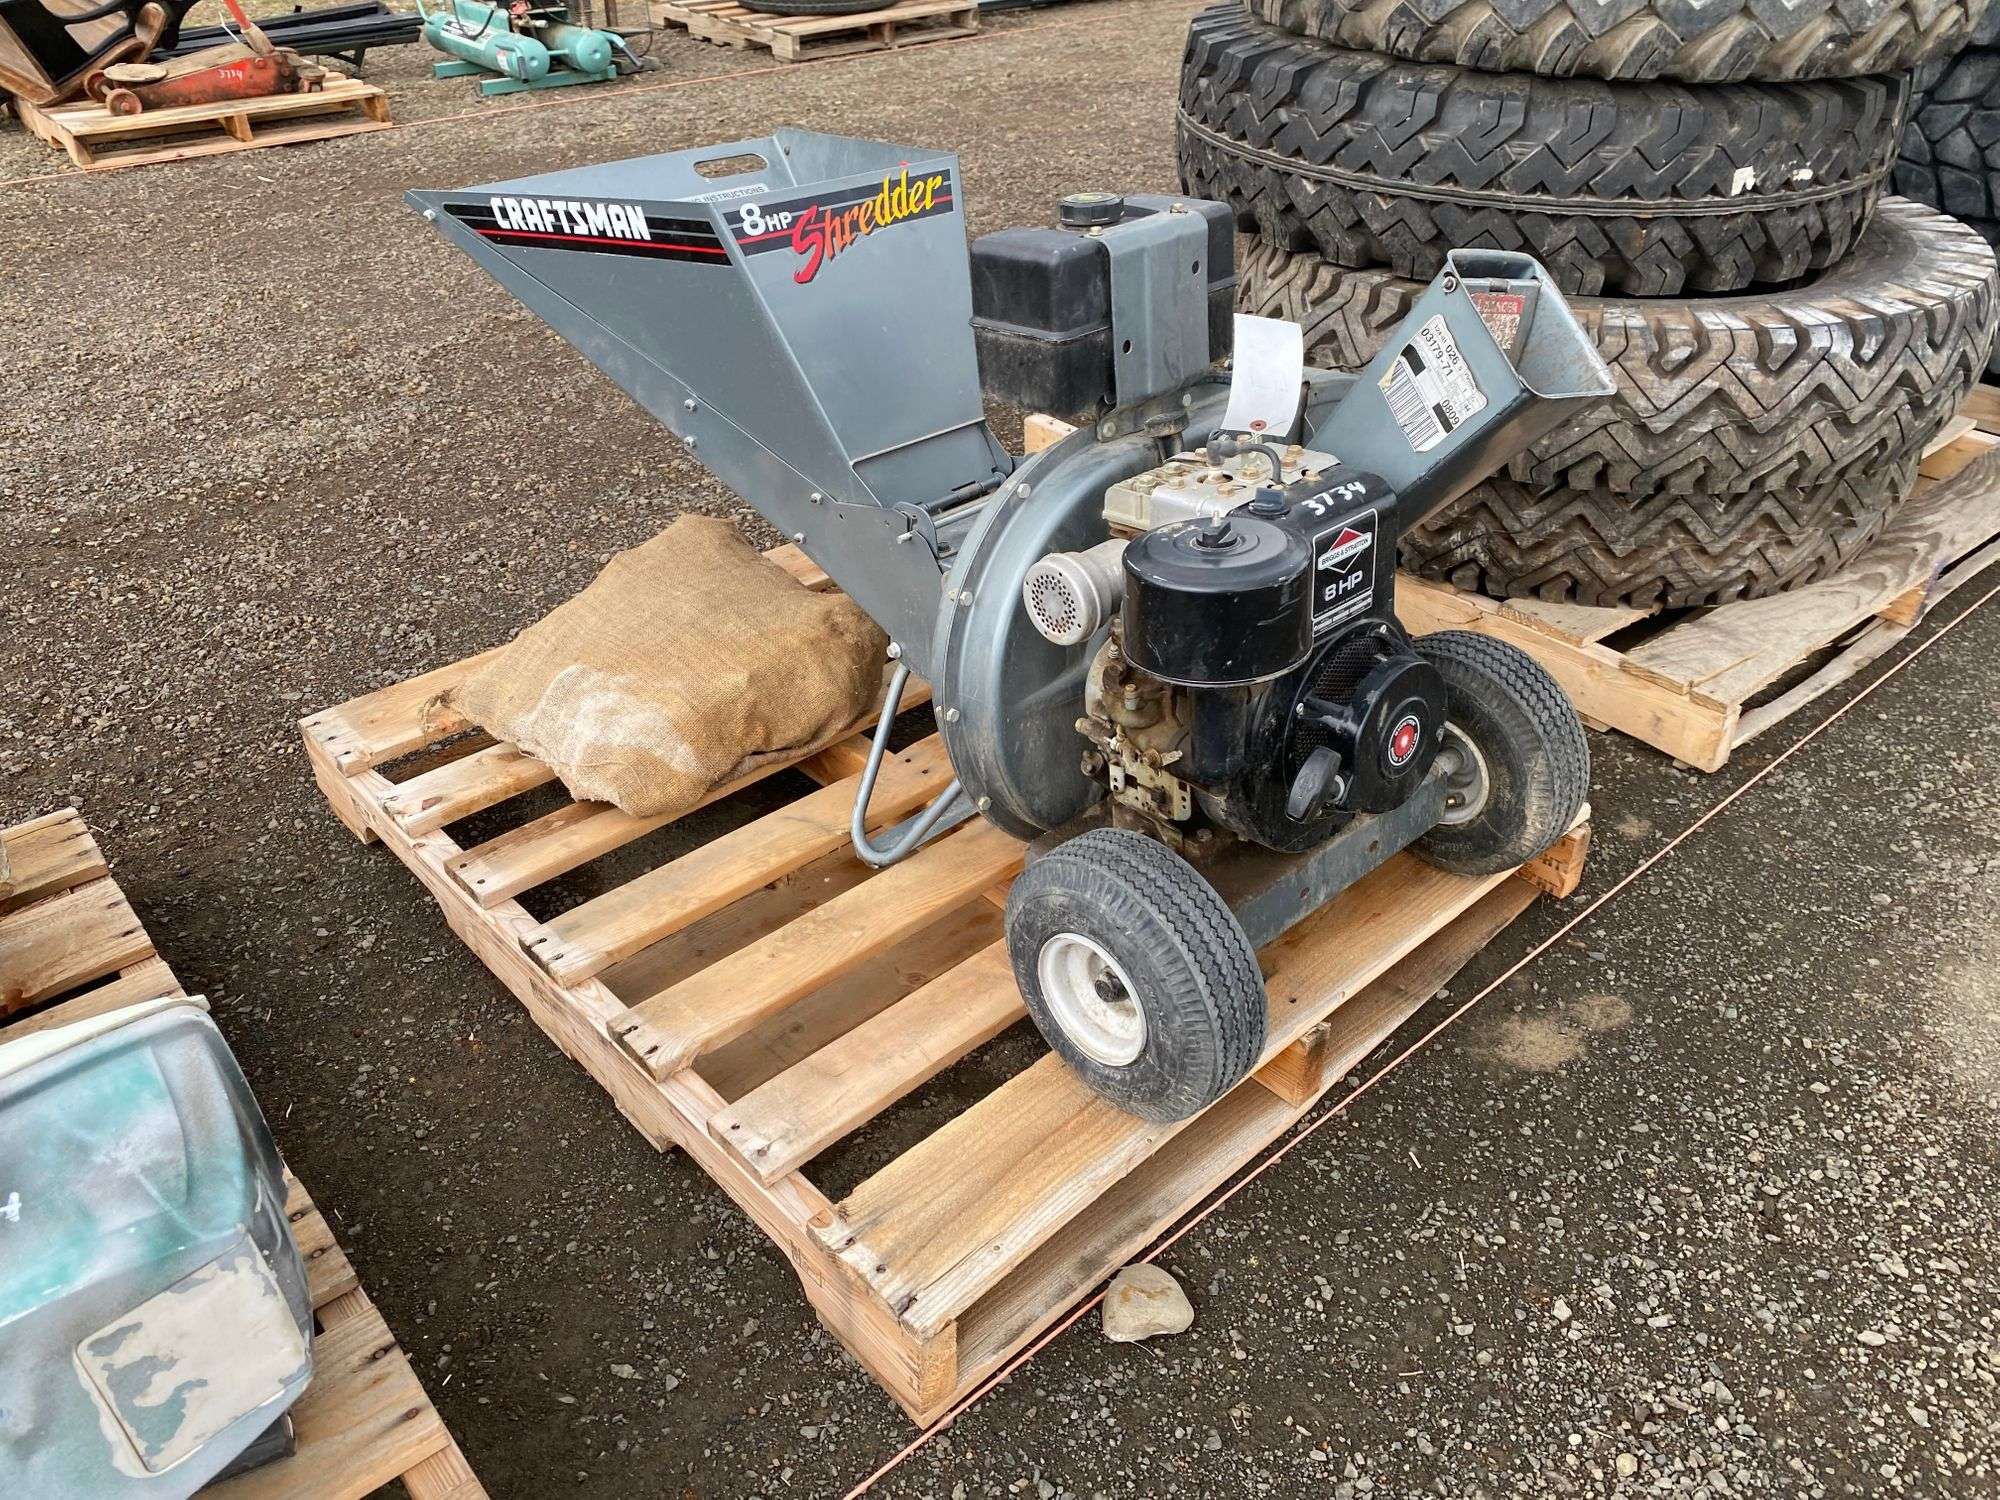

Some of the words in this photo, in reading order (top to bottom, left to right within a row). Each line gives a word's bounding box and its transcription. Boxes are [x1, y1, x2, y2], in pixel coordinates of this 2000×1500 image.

[489, 196, 651, 241] CRAFTSMAN
[740, 203, 766, 236] 8
[765, 212, 793, 231] HP
[792, 167, 944, 284] Shredder
[1421, 328, 1454, 377] 03179-71
[1444, 344, 1459, 365] 026
[1441, 399, 1460, 426] 0809
[1301, 481, 1366, 516] 3734
[1321, 551, 1341, 566] BRIGGS
[1344, 538, 1369, 555] STRATTON
[1323, 583, 1337, 602] 8
[1338, 569, 1364, 596] HP
